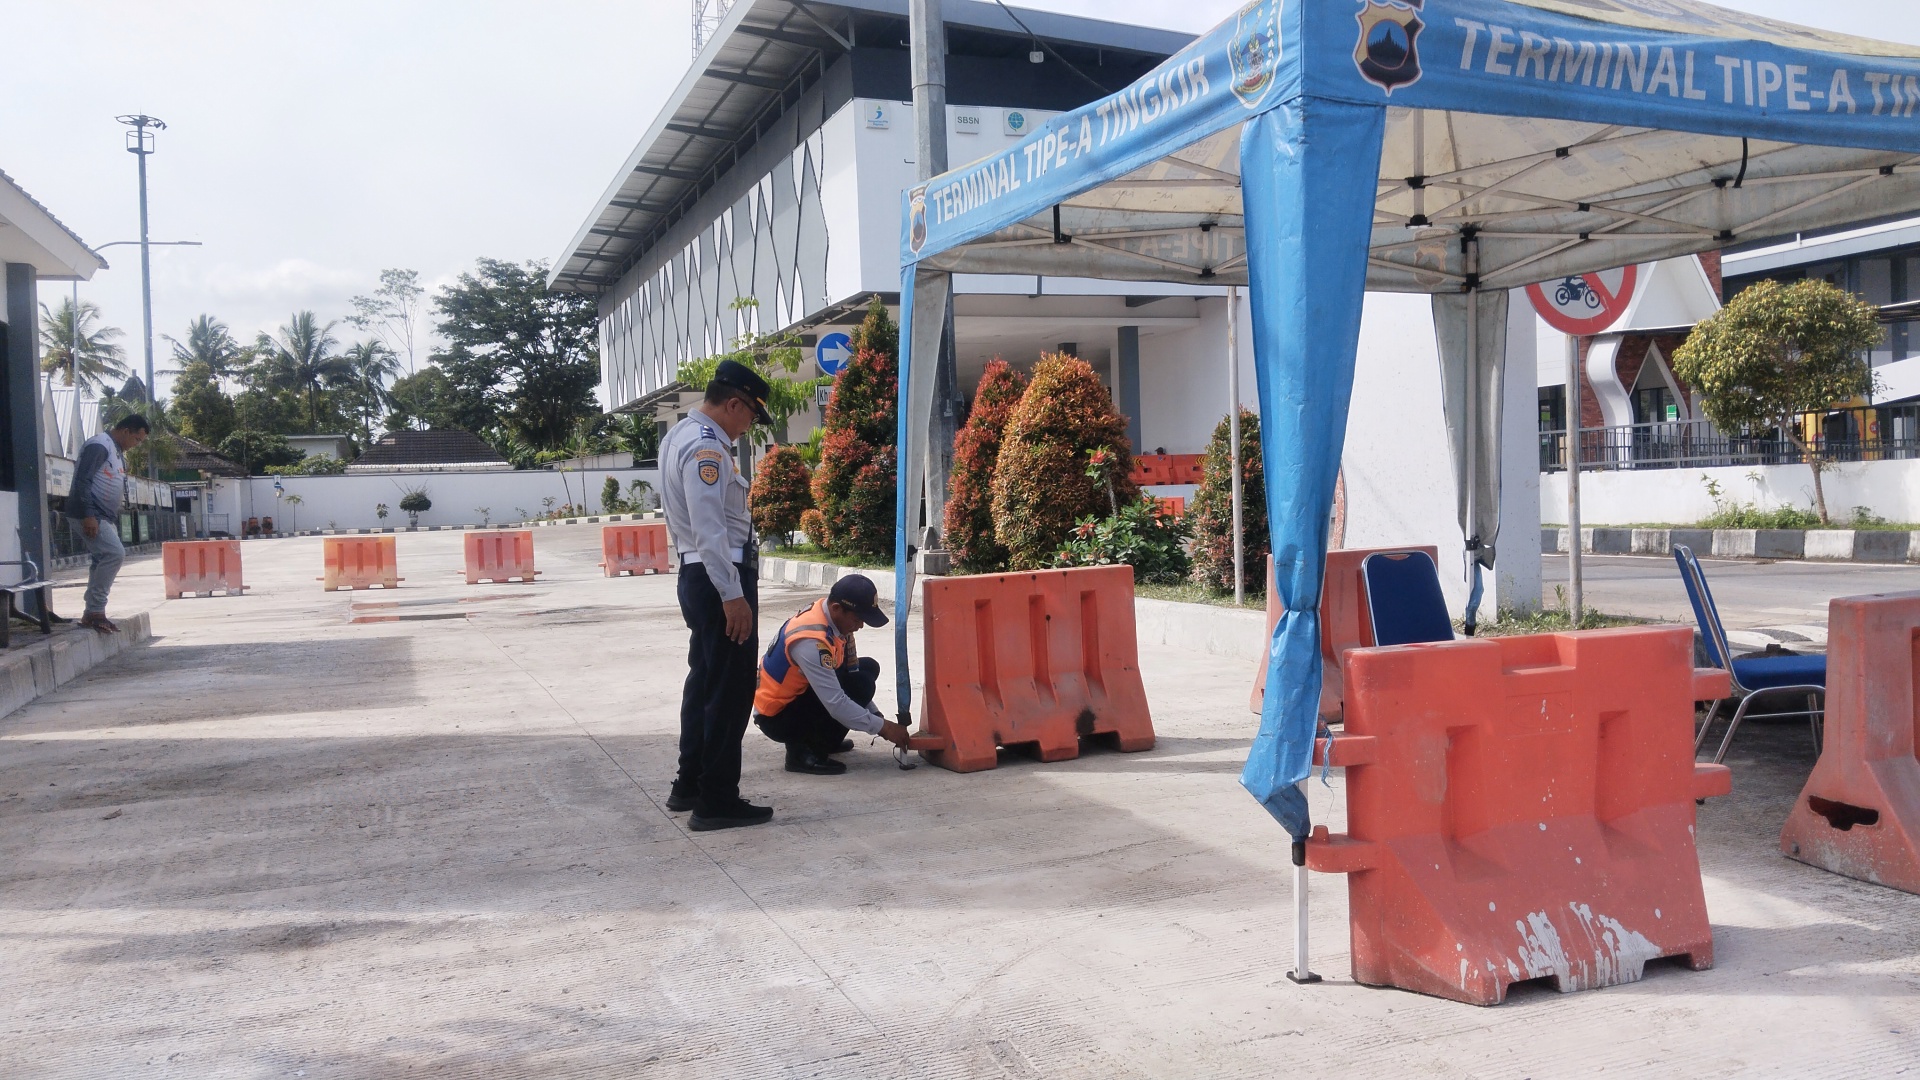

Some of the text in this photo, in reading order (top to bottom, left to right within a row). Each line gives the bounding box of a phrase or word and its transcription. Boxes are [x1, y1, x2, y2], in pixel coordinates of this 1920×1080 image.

[1454, 17, 1706, 100] TERMINAL
[1715, 55, 1856, 115] TIPE-A
[933, 54, 1210, 225] TERMINAL TIPE-A TINGKIR
[957, 115, 980, 125] SBSN
